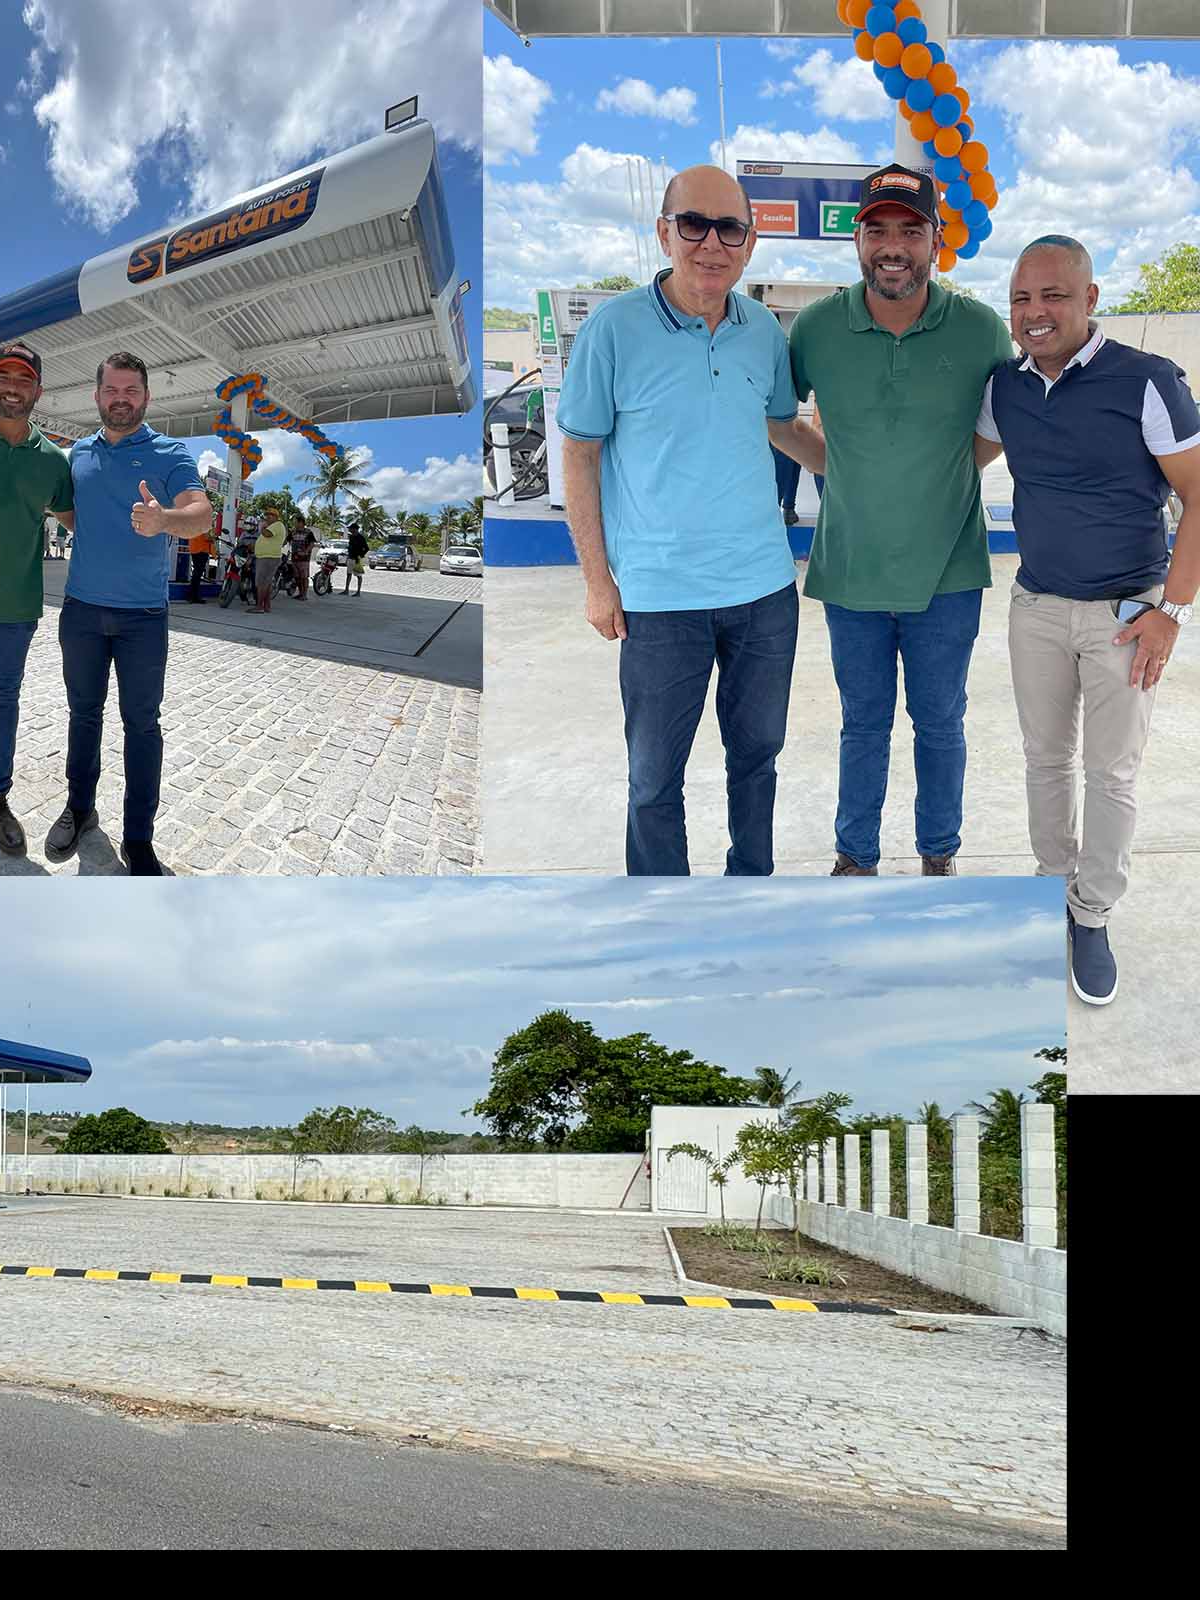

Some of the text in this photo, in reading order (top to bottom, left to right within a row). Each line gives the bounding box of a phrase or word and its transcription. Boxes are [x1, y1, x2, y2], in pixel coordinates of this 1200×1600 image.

[246, 180, 311, 211] AUTO POSTO
[169, 188, 311, 260] Santana
